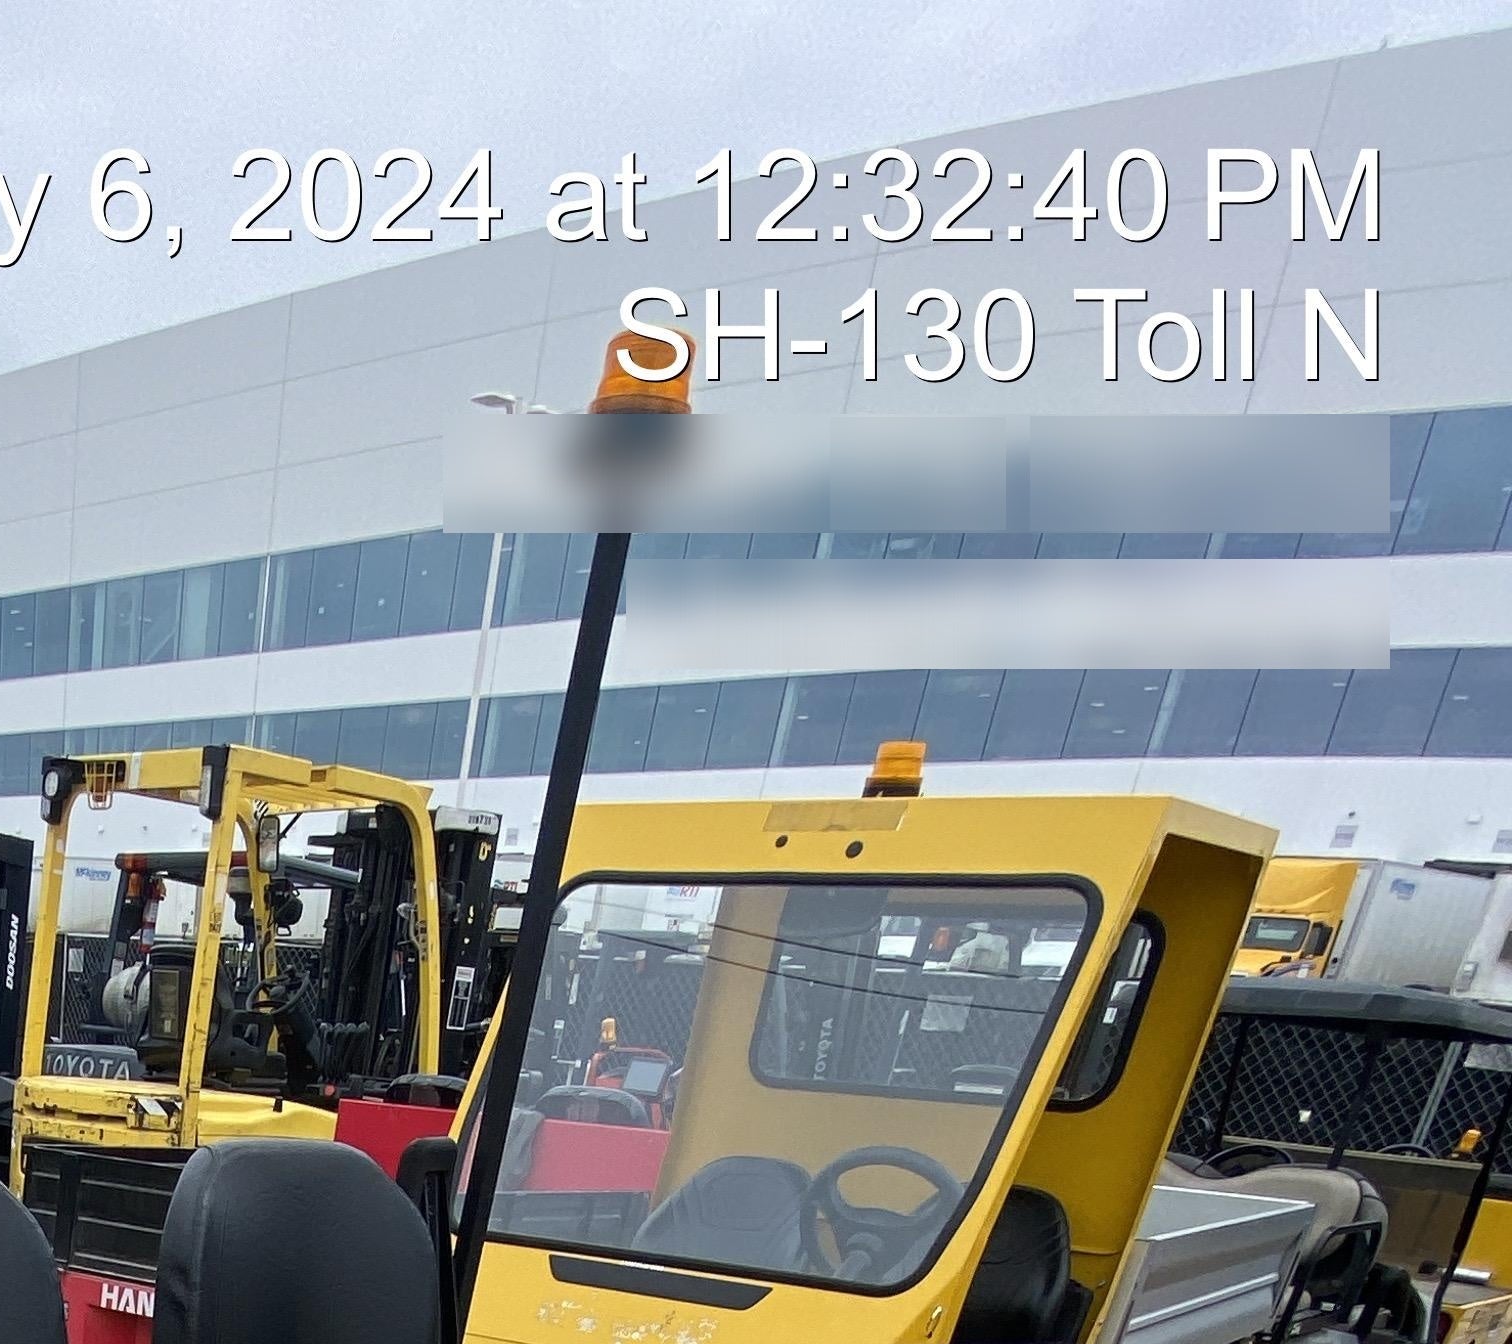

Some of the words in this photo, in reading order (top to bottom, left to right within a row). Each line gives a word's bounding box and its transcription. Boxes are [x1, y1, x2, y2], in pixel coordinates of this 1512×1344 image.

[5, 913, 19, 990] DOOSAN
[813, 1017, 834, 1081] TOYOTA
[100, 1283, 155, 1318] HAN
